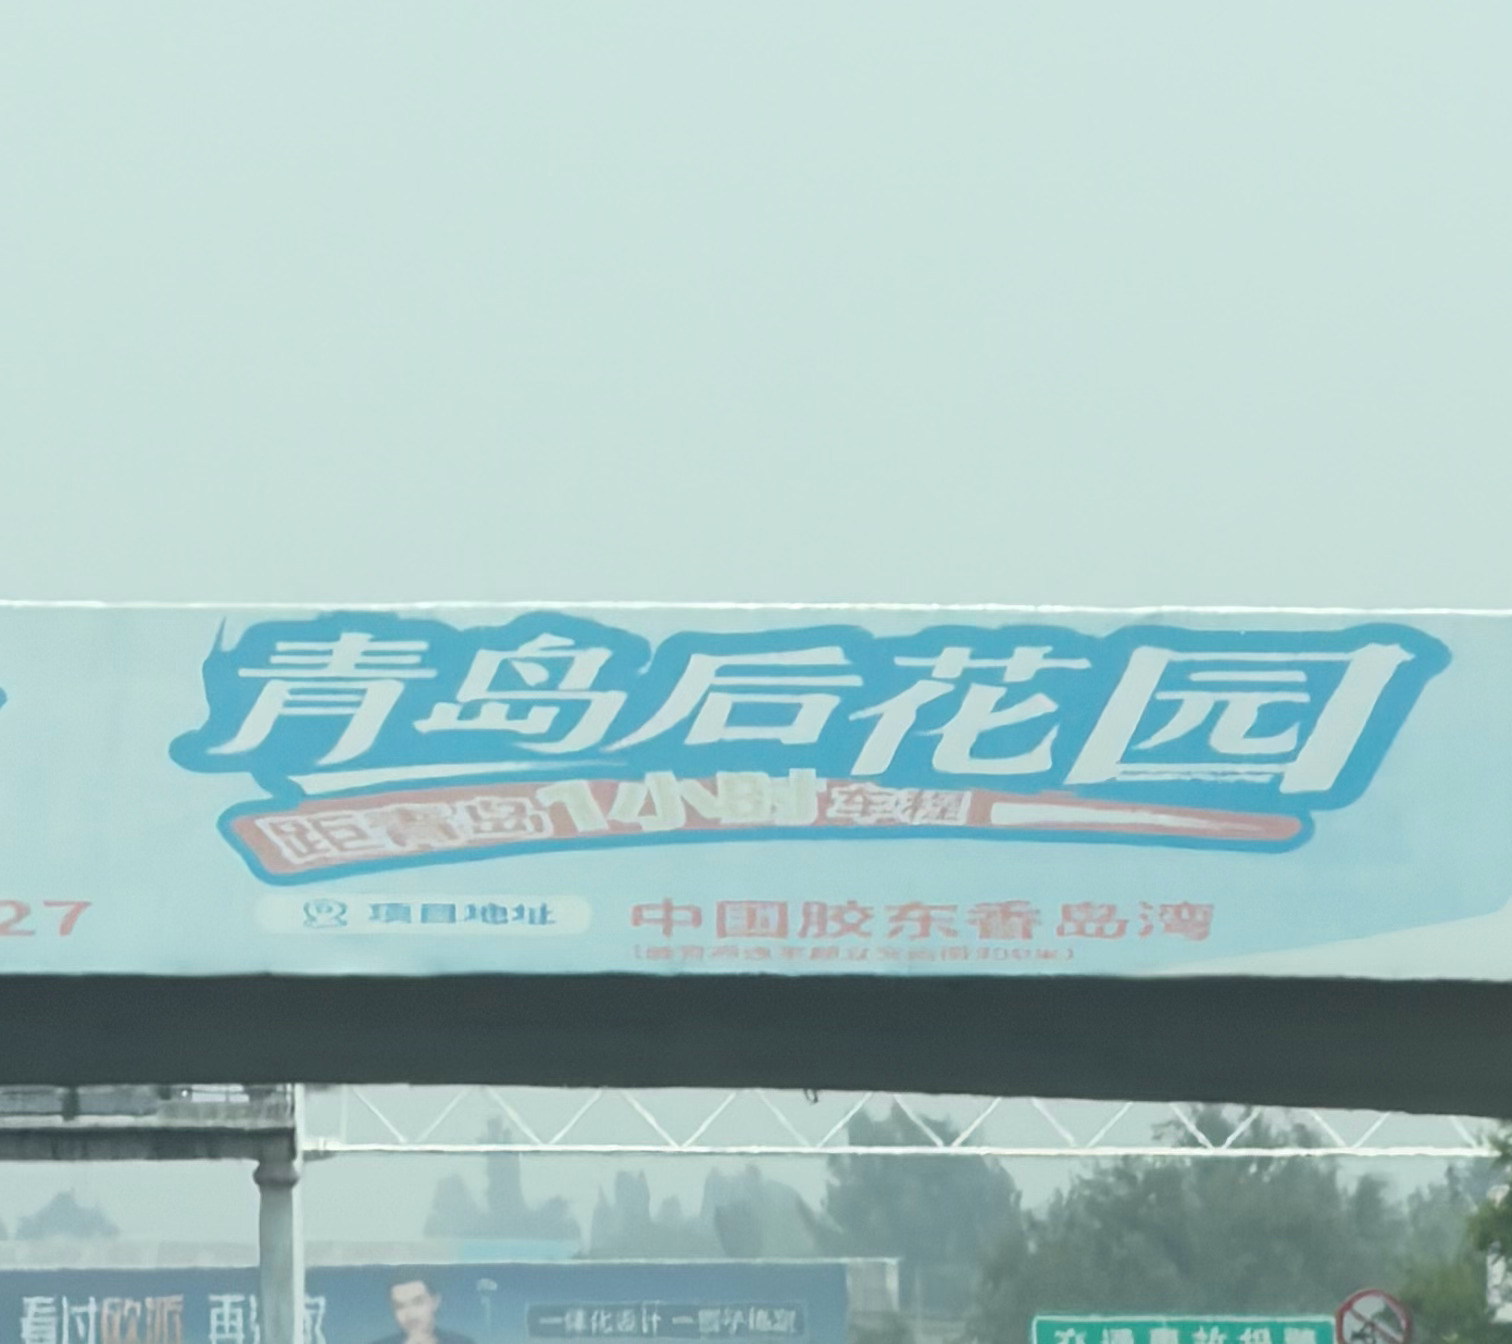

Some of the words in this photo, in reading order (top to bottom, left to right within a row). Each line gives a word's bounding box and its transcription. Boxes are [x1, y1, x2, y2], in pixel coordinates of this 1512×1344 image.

[207, 632, 1413, 794] 青岛后花园
[369, 902, 556, 926] 项目地址
[630, 899, 1214, 941] 中国胶东香岛湾
